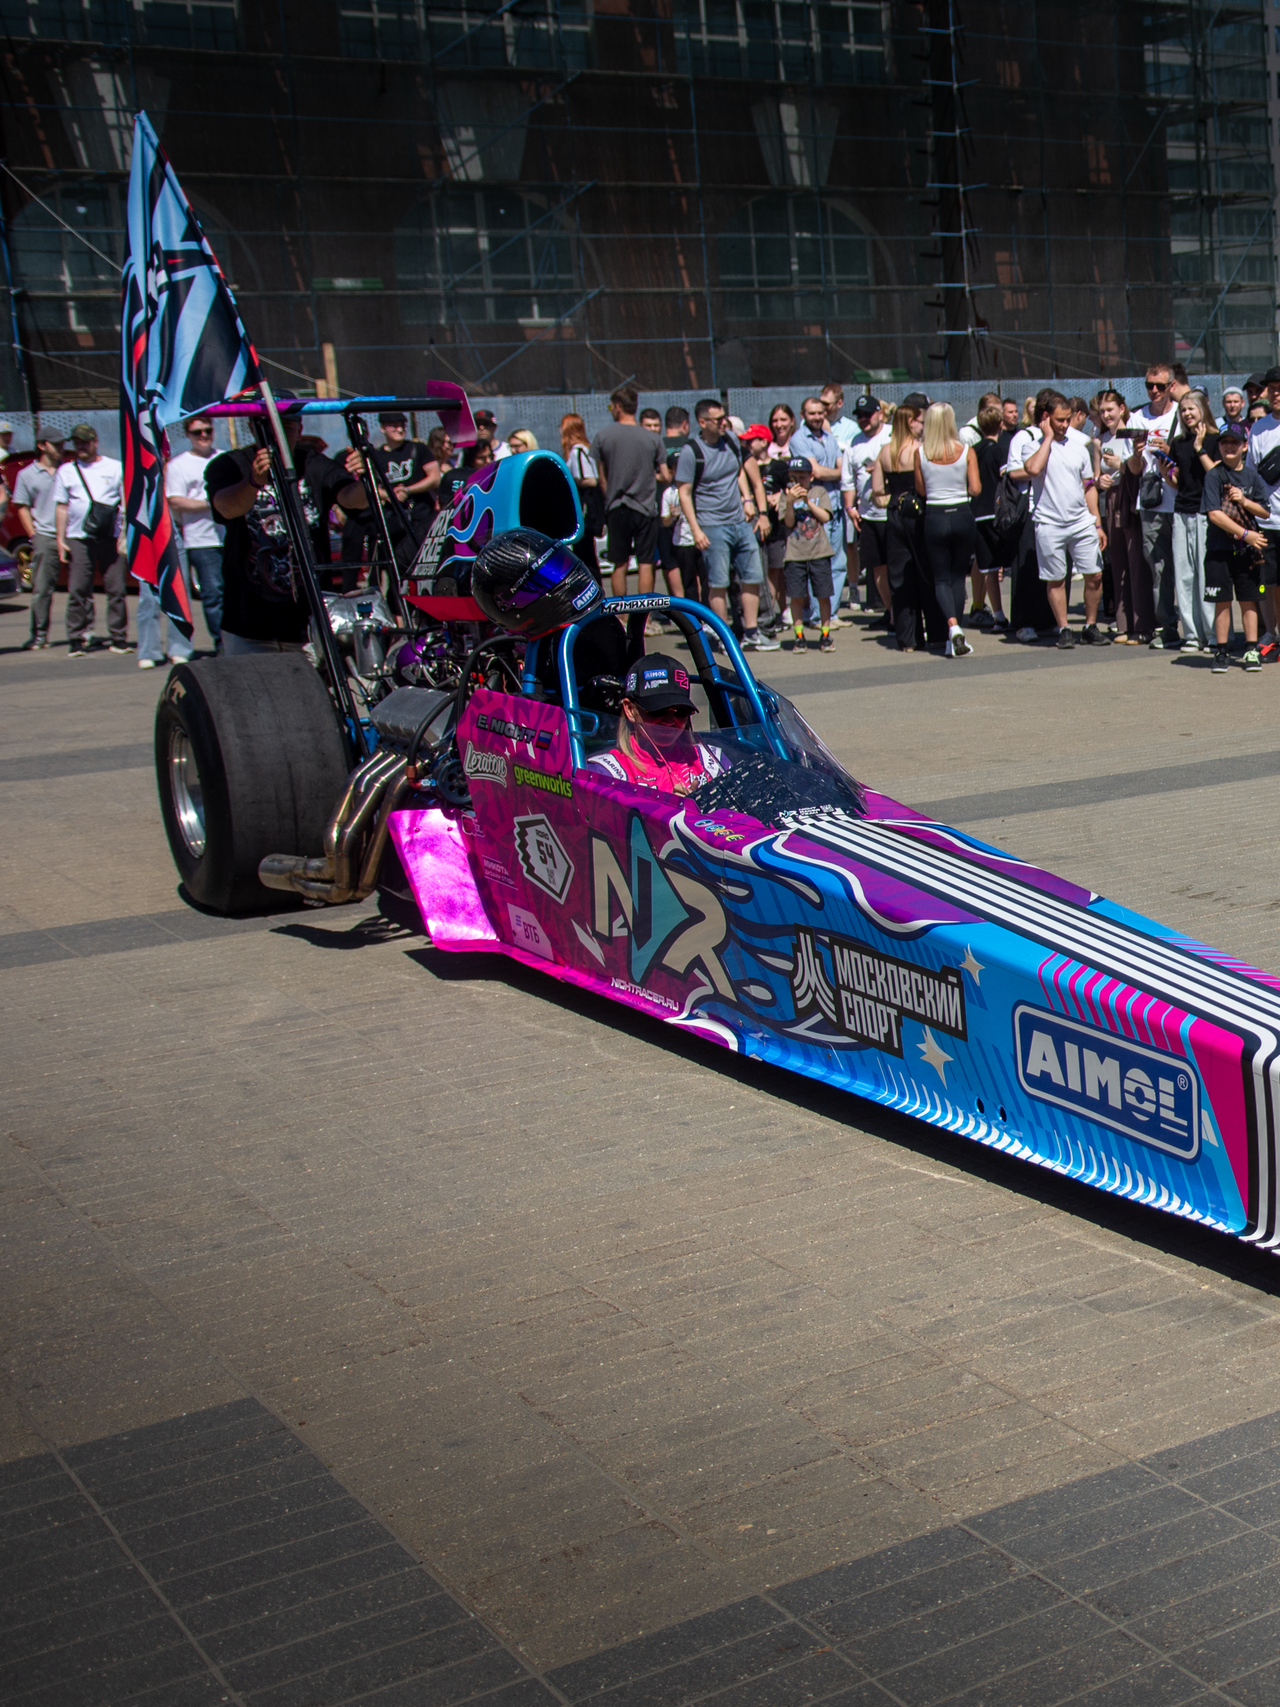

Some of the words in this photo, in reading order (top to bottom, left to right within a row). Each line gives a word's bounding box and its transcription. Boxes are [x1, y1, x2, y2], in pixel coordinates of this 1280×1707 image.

[531, 547, 556, 571] RACER
[477, 714, 488, 729] E.
[490, 718, 536, 744] NIGHT
[514, 765, 573, 799] greenworks
[536, 839, 557, 869] 54
[522, 921, 540, 944] ВТБ
[833, 944, 963, 1031] МОСКОВСКИЙ
[840, 989, 899, 1049] СПОРТ
